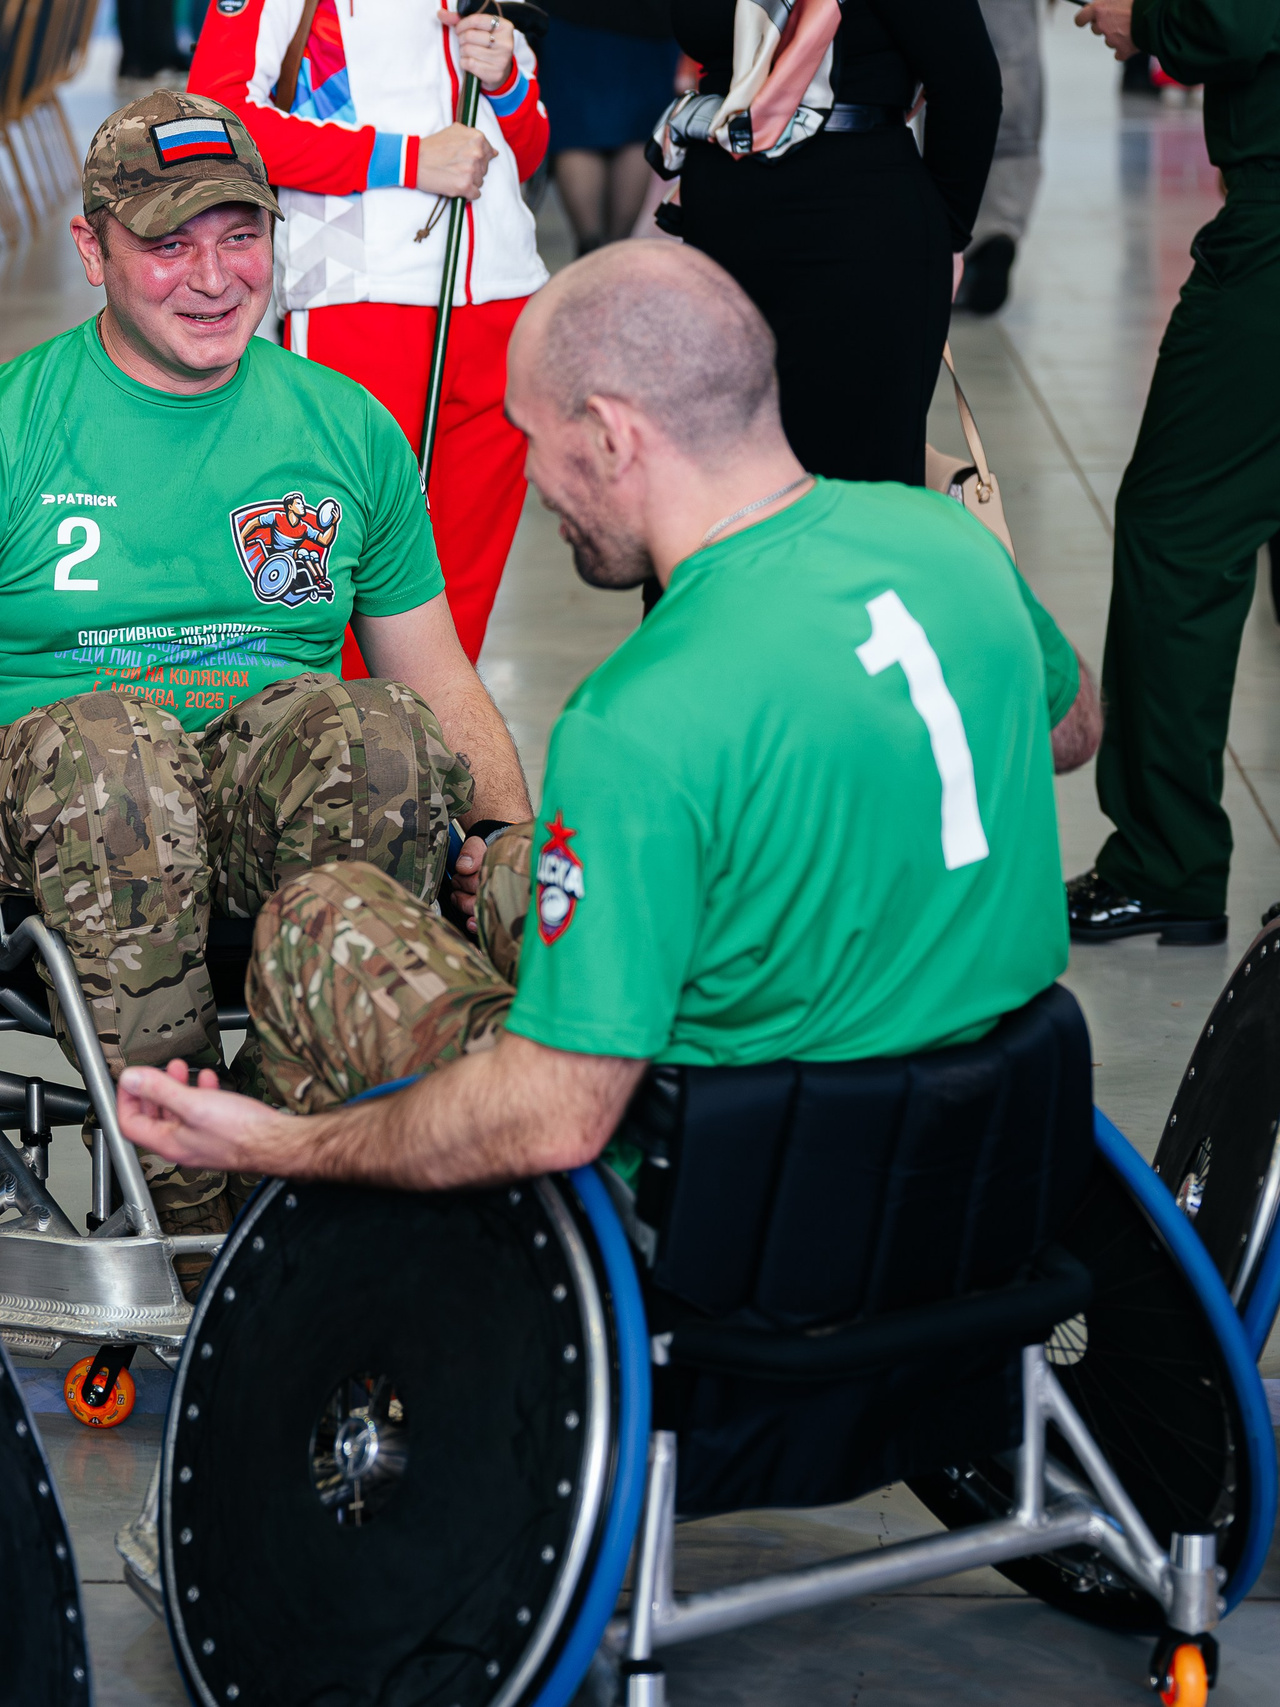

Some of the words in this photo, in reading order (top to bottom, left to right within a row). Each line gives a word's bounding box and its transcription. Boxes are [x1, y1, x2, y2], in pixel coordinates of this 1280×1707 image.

[57, 493, 118, 507] PATRICK
[54, 516, 101, 591] 2
[78, 626, 176, 647] СПОРТИВНОЕ
[160, 649, 259, 667] ОРАЖЕНИЕМ
[144, 665, 165, 683] НА
[169, 668, 250, 688] КОЛЯСКАХ
[185, 691, 225, 709] 2025
[854, 588, 990, 871] 1
